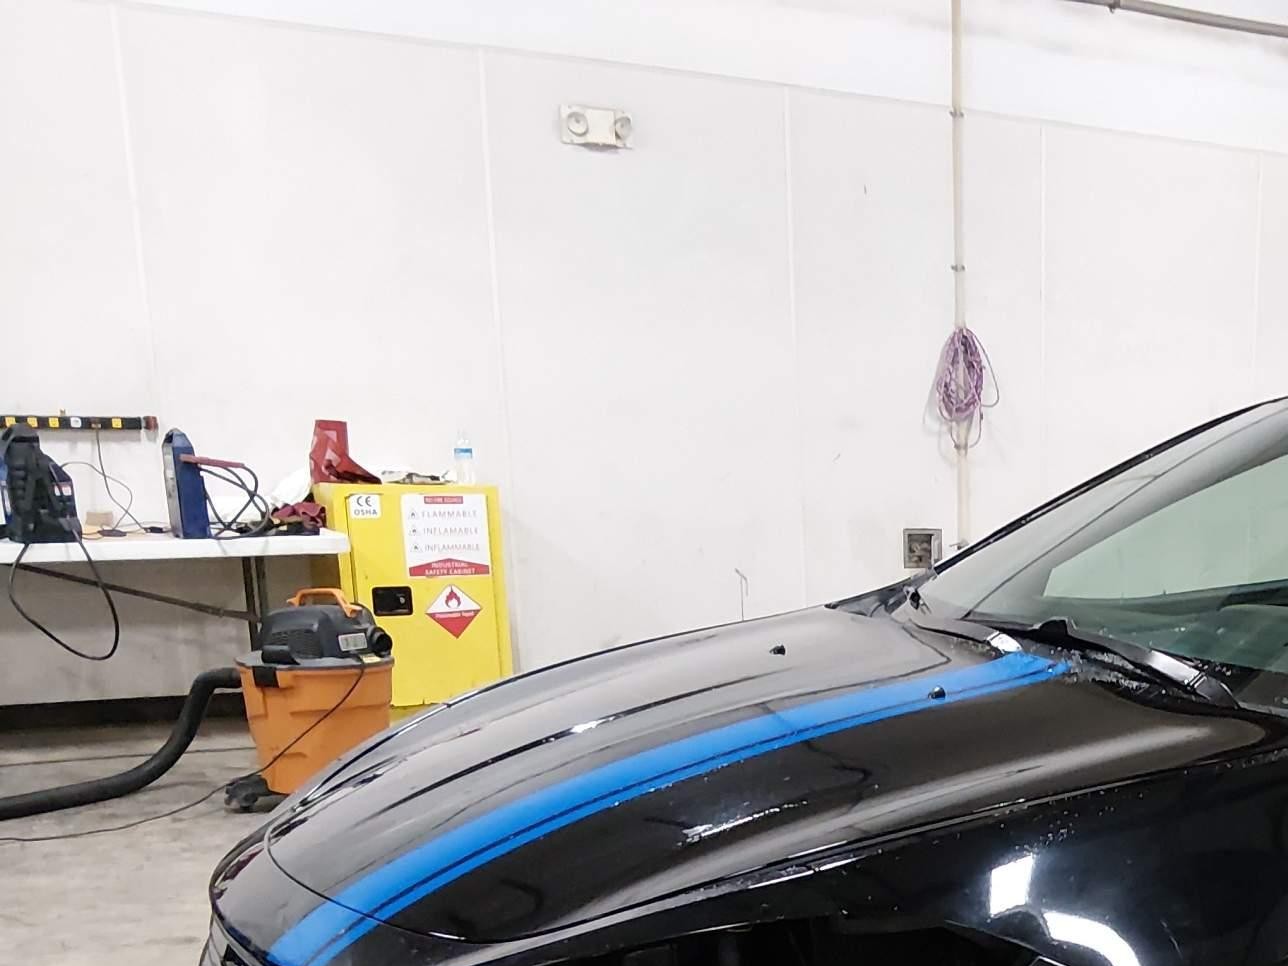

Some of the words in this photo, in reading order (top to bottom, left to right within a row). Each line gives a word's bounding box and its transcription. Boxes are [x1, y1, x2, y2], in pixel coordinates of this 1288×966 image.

[353, 508, 378, 516] OSHA
[421, 509, 477, 519] FLAMMABLE
[424, 543, 480, 553] INFLAMMABLE
